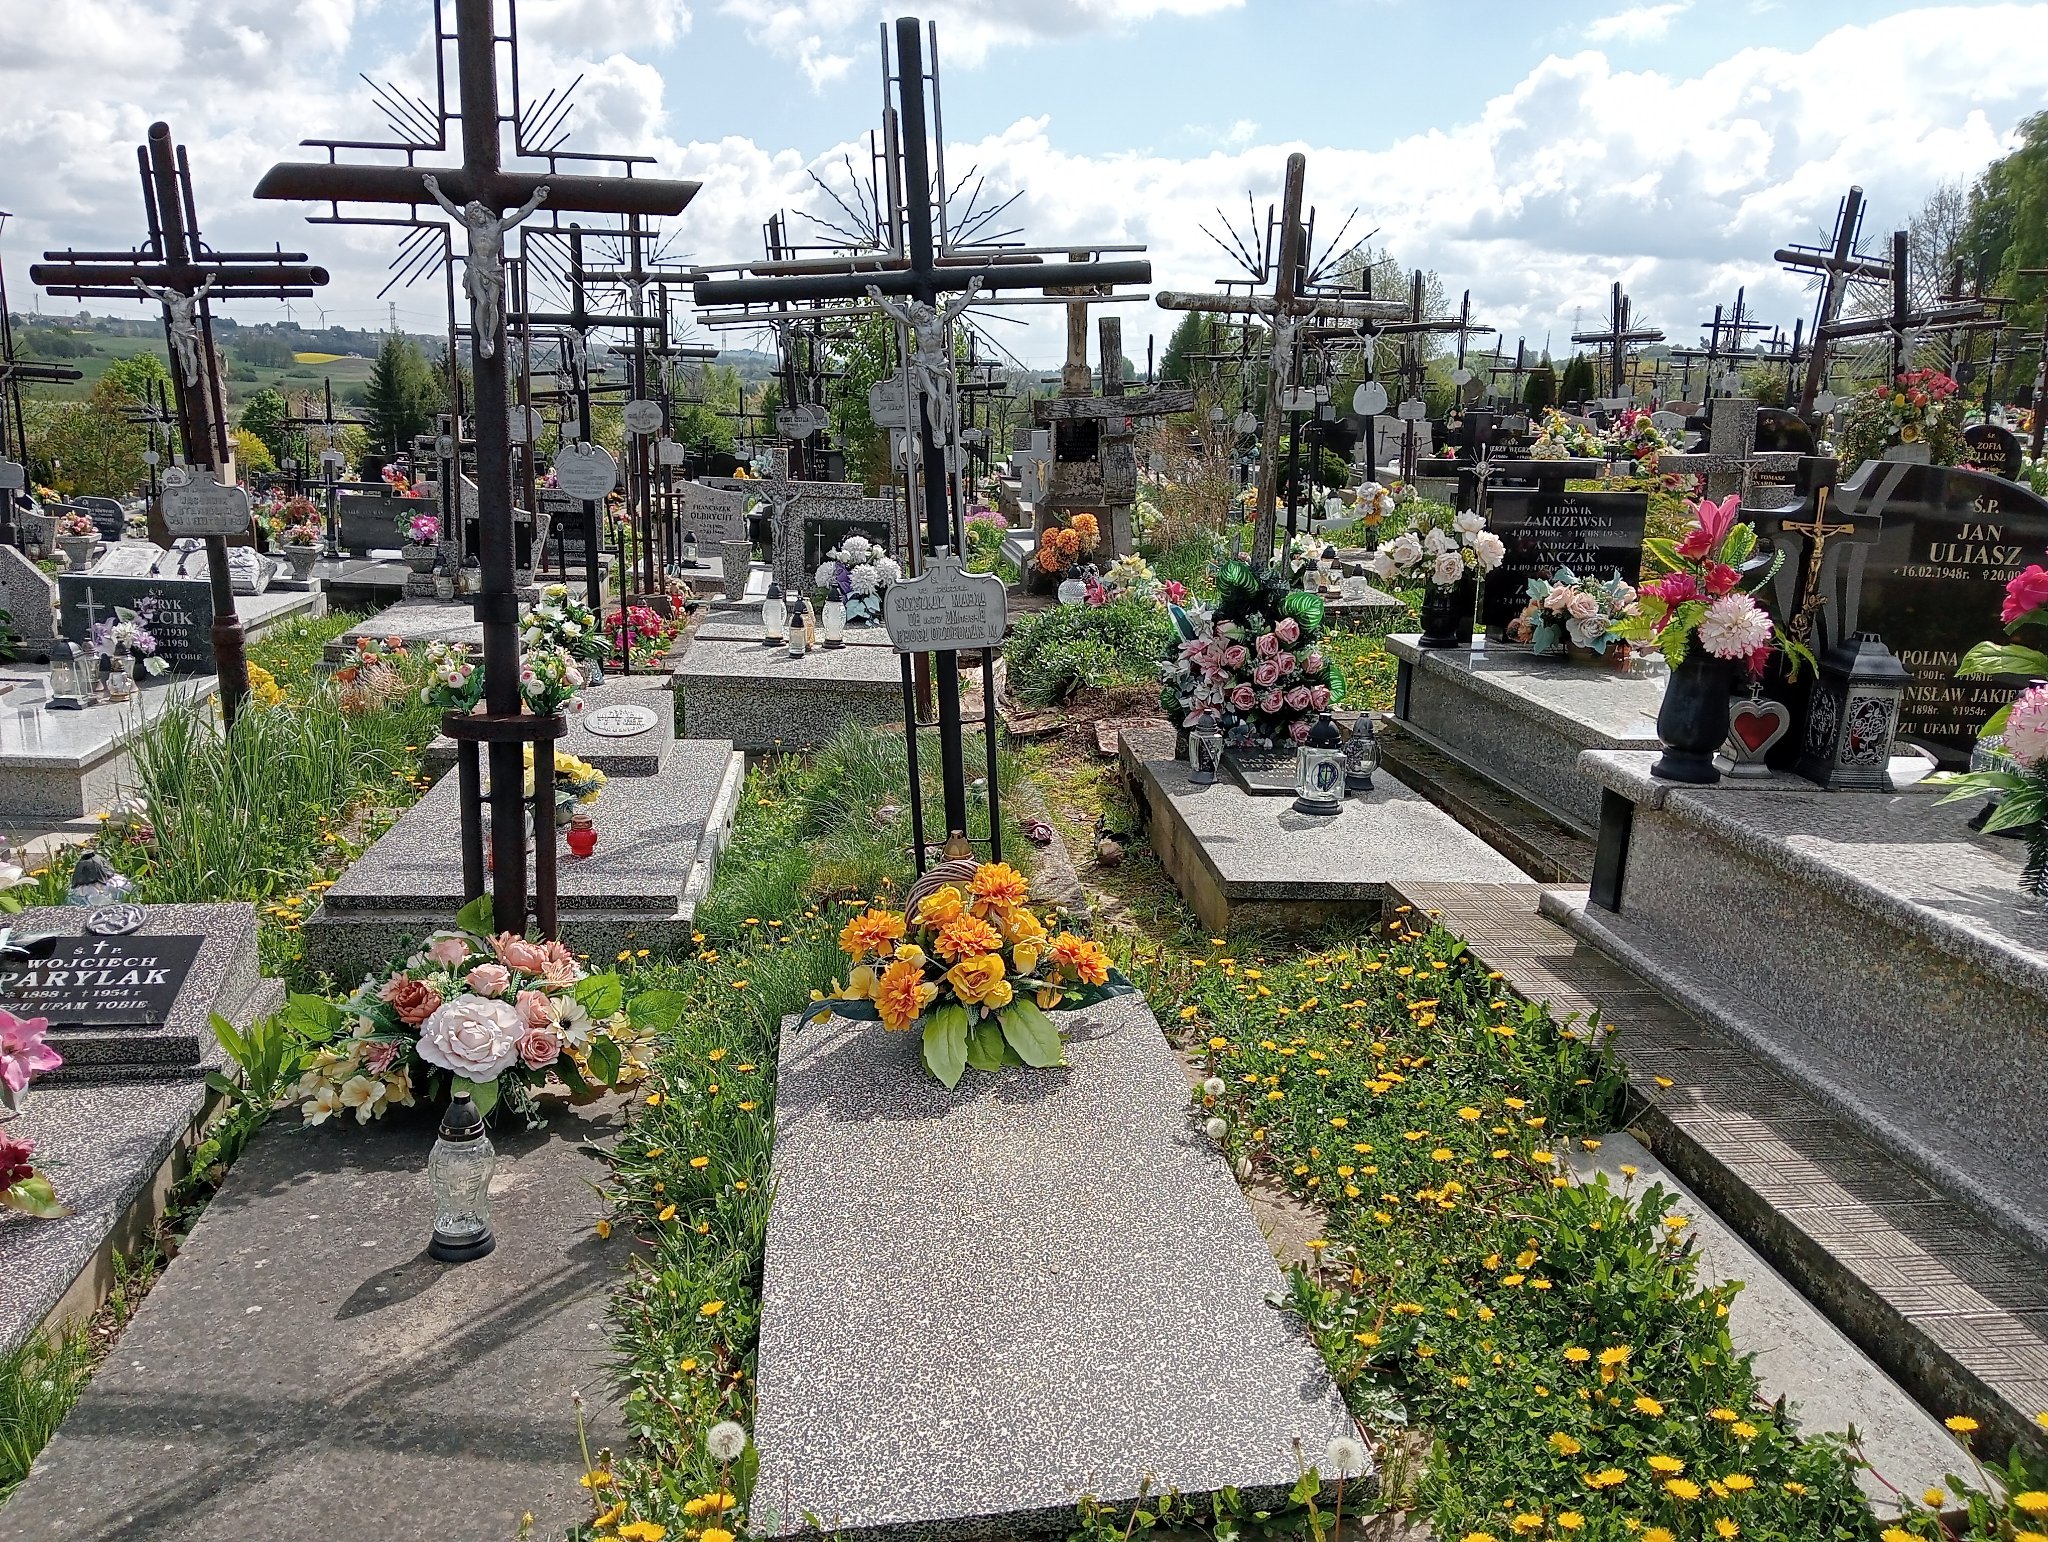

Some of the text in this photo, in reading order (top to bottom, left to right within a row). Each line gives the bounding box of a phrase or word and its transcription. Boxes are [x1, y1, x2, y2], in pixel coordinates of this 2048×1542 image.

[1976, 442, 2002, 451] ZOFIA
[693, 503, 732, 512] FRANCISZEK
[1973, 494, 2000, 514] Ś.P.
[1546, 506, 1593, 515] LUDWIK
[690, 512, 734, 521] OLBRYCHT
[1524, 516, 1613, 528] ZAKRZEWSKI
[1957, 523, 2004, 542] JAN
[1536, 552, 1597, 563] ANCZAK
[1929, 542, 2023, 566] ULIASZ
[133, 598, 182, 610] HRYK
[1918, 670, 1946, 681] 1901r.
[1923, 723, 1960, 735] UFAM
[27, 957, 159, 969] WOJCIECH
[0, 968, 171, 988] PARYLAK
[22, 989, 60, 999] 1888
[93, 989, 130, 997] 1954
[40, 1001, 90, 1011] UFAM
[95, 1000, 149, 1010] TOBIE
